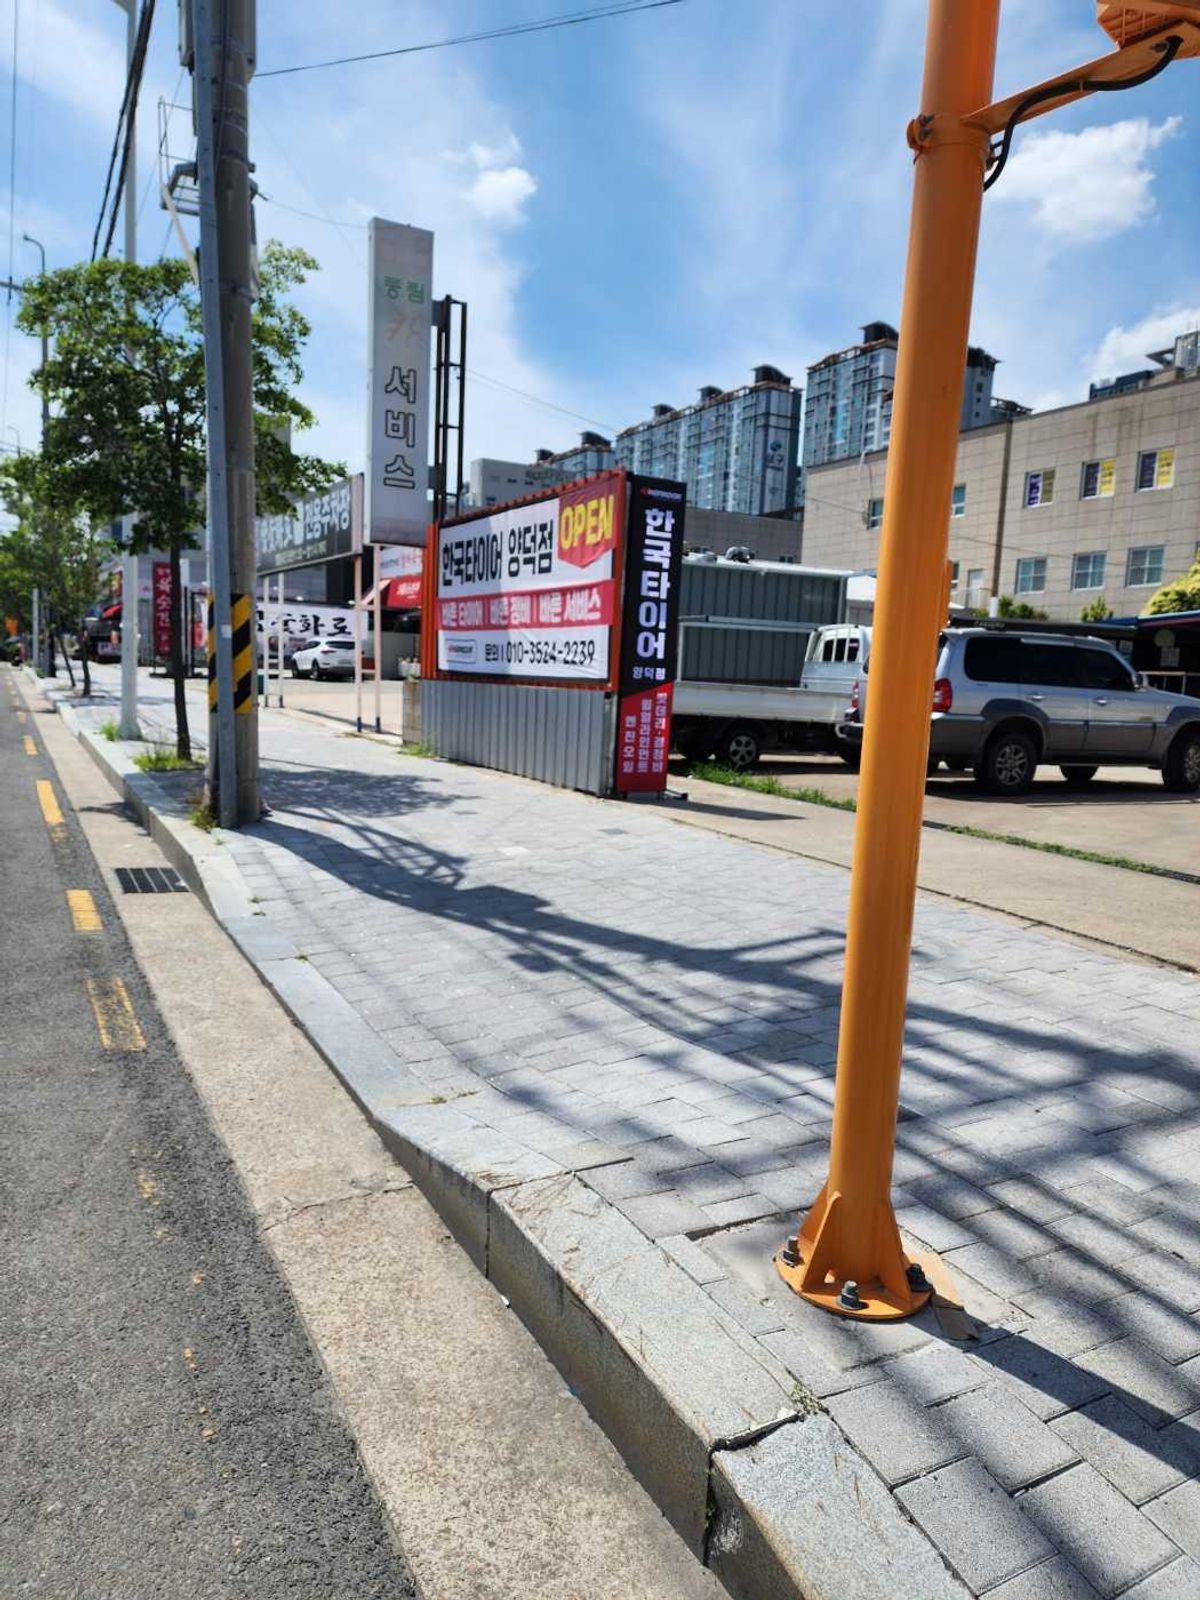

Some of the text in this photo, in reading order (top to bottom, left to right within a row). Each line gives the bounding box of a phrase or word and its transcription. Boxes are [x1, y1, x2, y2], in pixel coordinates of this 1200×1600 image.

[383, 366, 417, 491] 서비스
[442, 519, 554, 587] 한국타이어 양덕점
[559, 494, 615, 550] OPEN
[563, 587, 601, 621] 서비스
[636, 508, 676, 660] 한국타이어
[506, 639, 596, 666] 010-3524-2239
